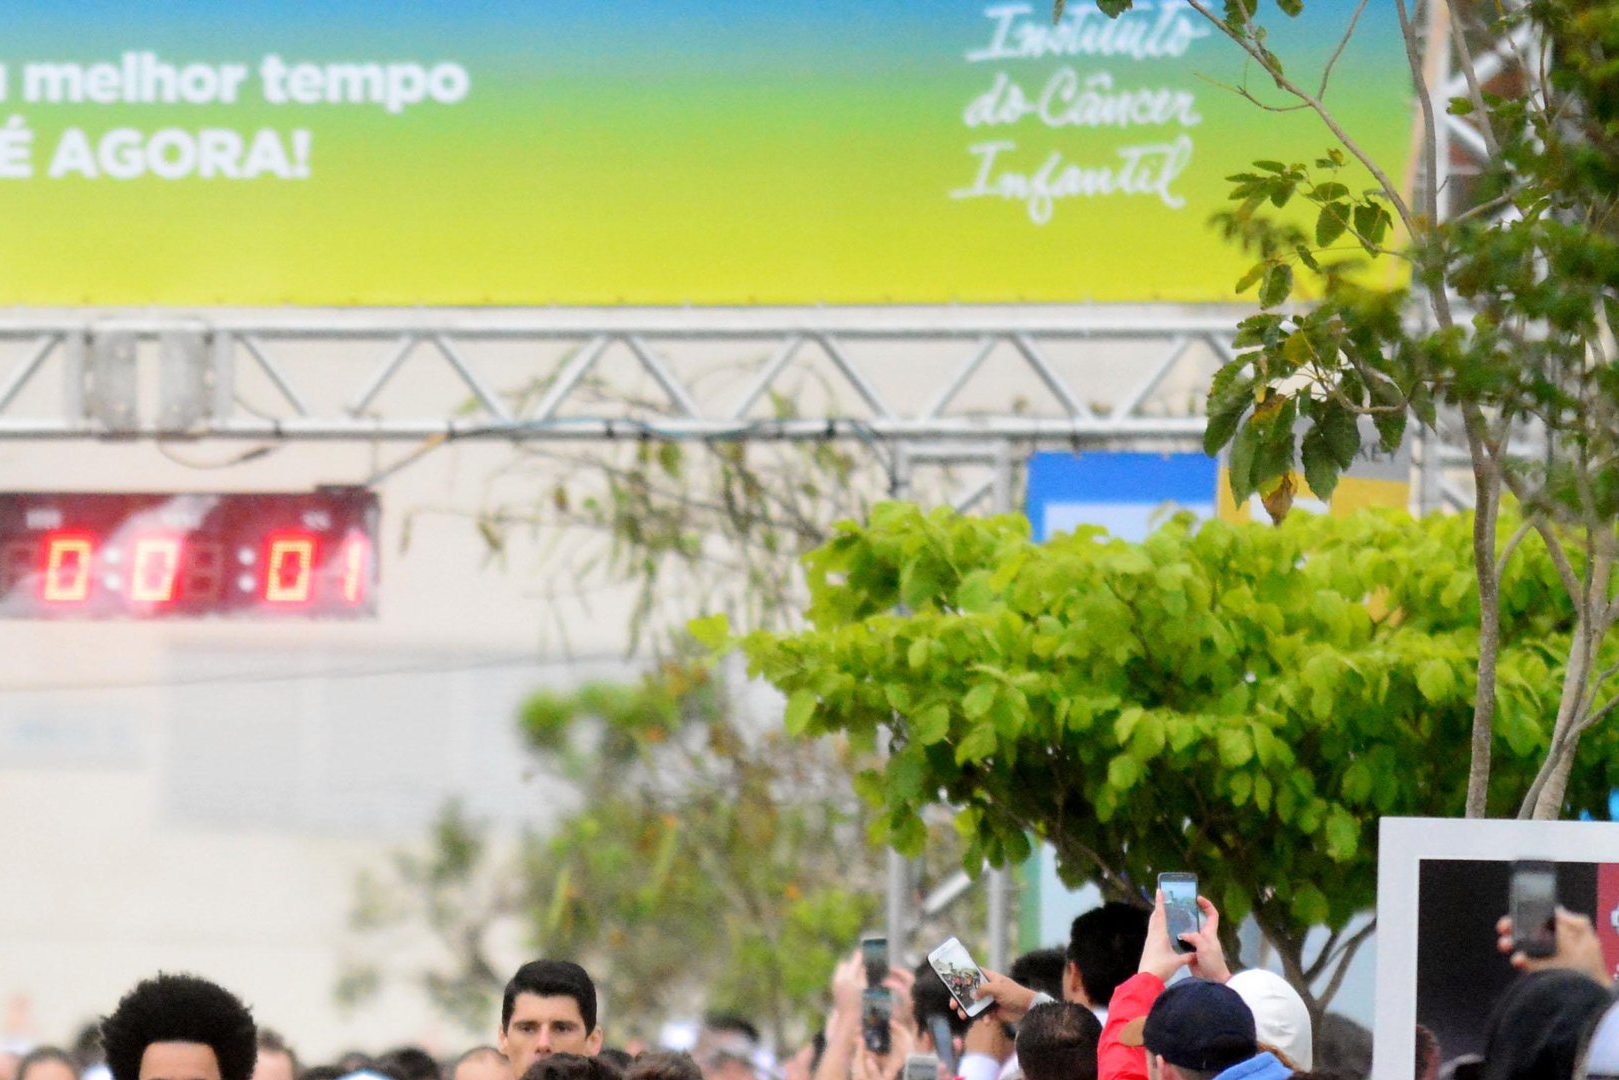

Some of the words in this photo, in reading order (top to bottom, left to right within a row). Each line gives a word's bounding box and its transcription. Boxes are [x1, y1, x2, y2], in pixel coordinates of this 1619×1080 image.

[23, 51, 249, 103] melhor
[259, 55, 470, 114] tempo
[1038, 65, 1203, 129] Câncer
[49, 127, 313, 179] AGORA!
[950, 134, 1194, 226] Infantil
